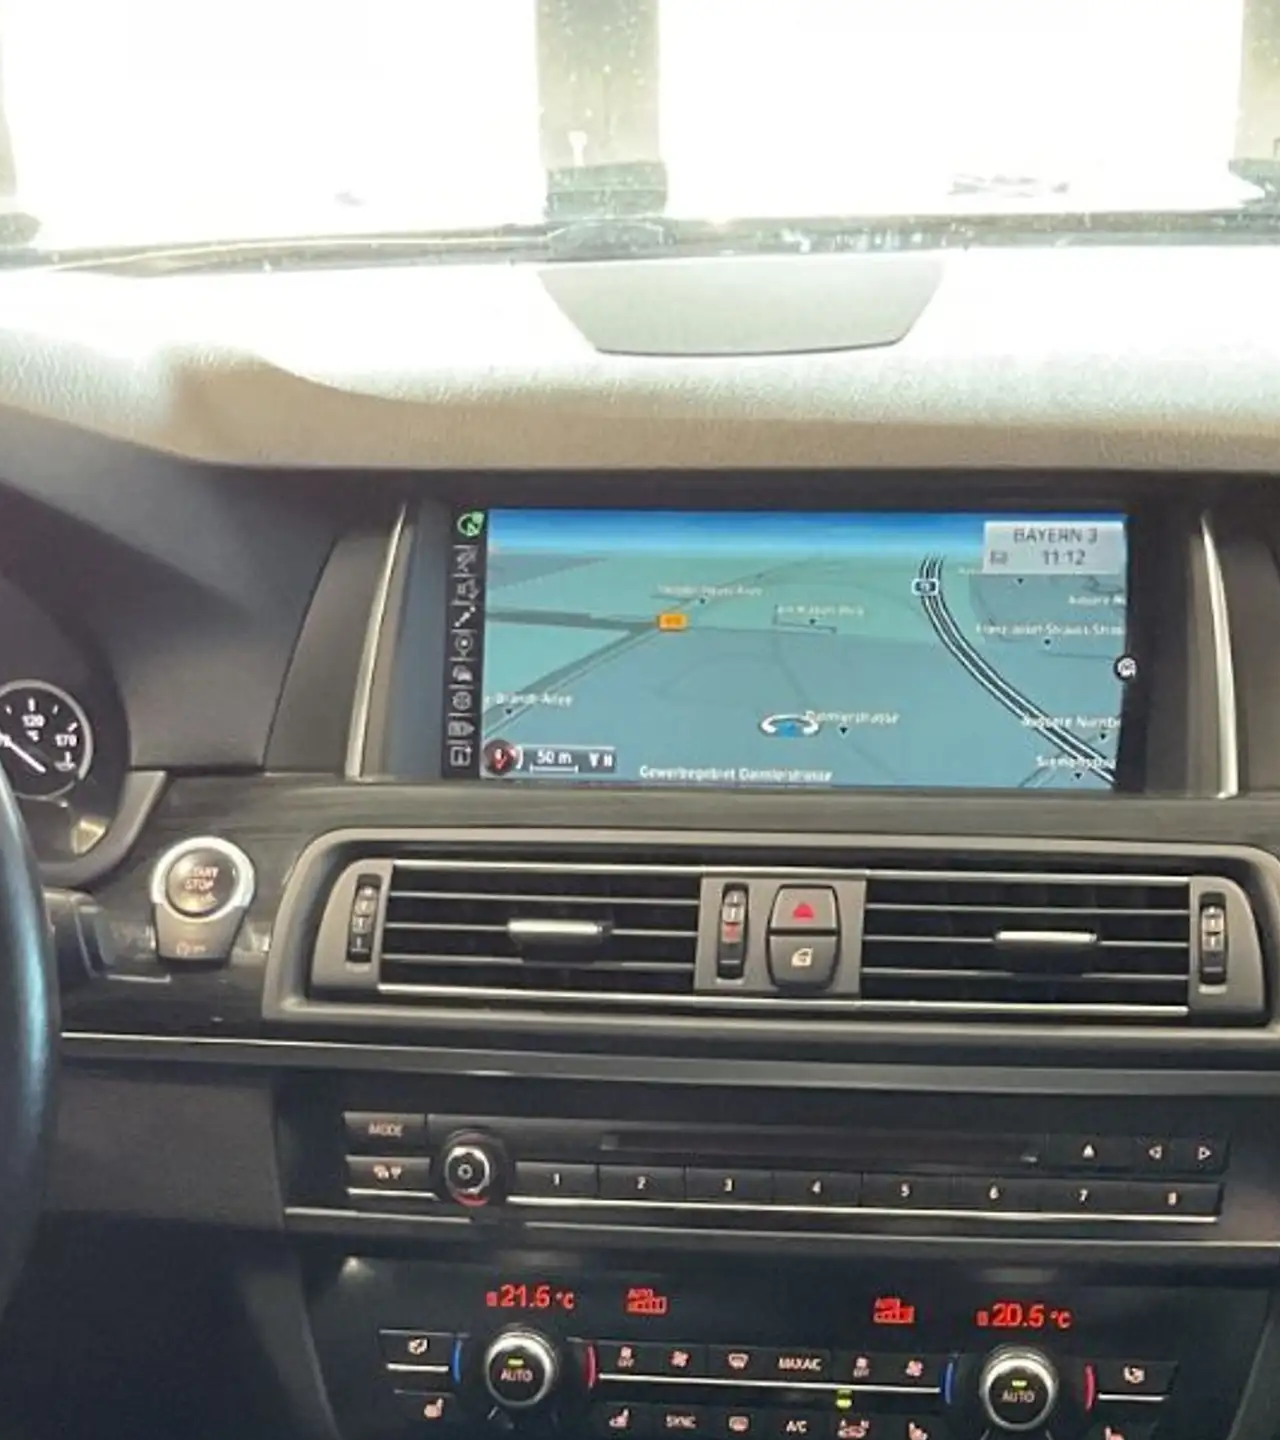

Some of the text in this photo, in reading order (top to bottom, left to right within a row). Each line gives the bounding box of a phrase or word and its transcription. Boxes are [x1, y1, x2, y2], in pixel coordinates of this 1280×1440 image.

[1013, 527, 1098, 544] BAYERN 3
[536, 749, 555, 765] 50
[553, 1172, 561, 1187] 1
[637, 1176, 646, 1190] 2
[724, 1178, 733, 1192] 3
[812, 1181, 821, 1194] 4
[900, 1183, 909, 1197] 5
[989, 1186, 999, 1200] 6
[1078, 1189, 1088, 1203] 7
[500, 1368, 534, 1383] AUTO
[1001, 1389, 1036, 1404] AUTO
